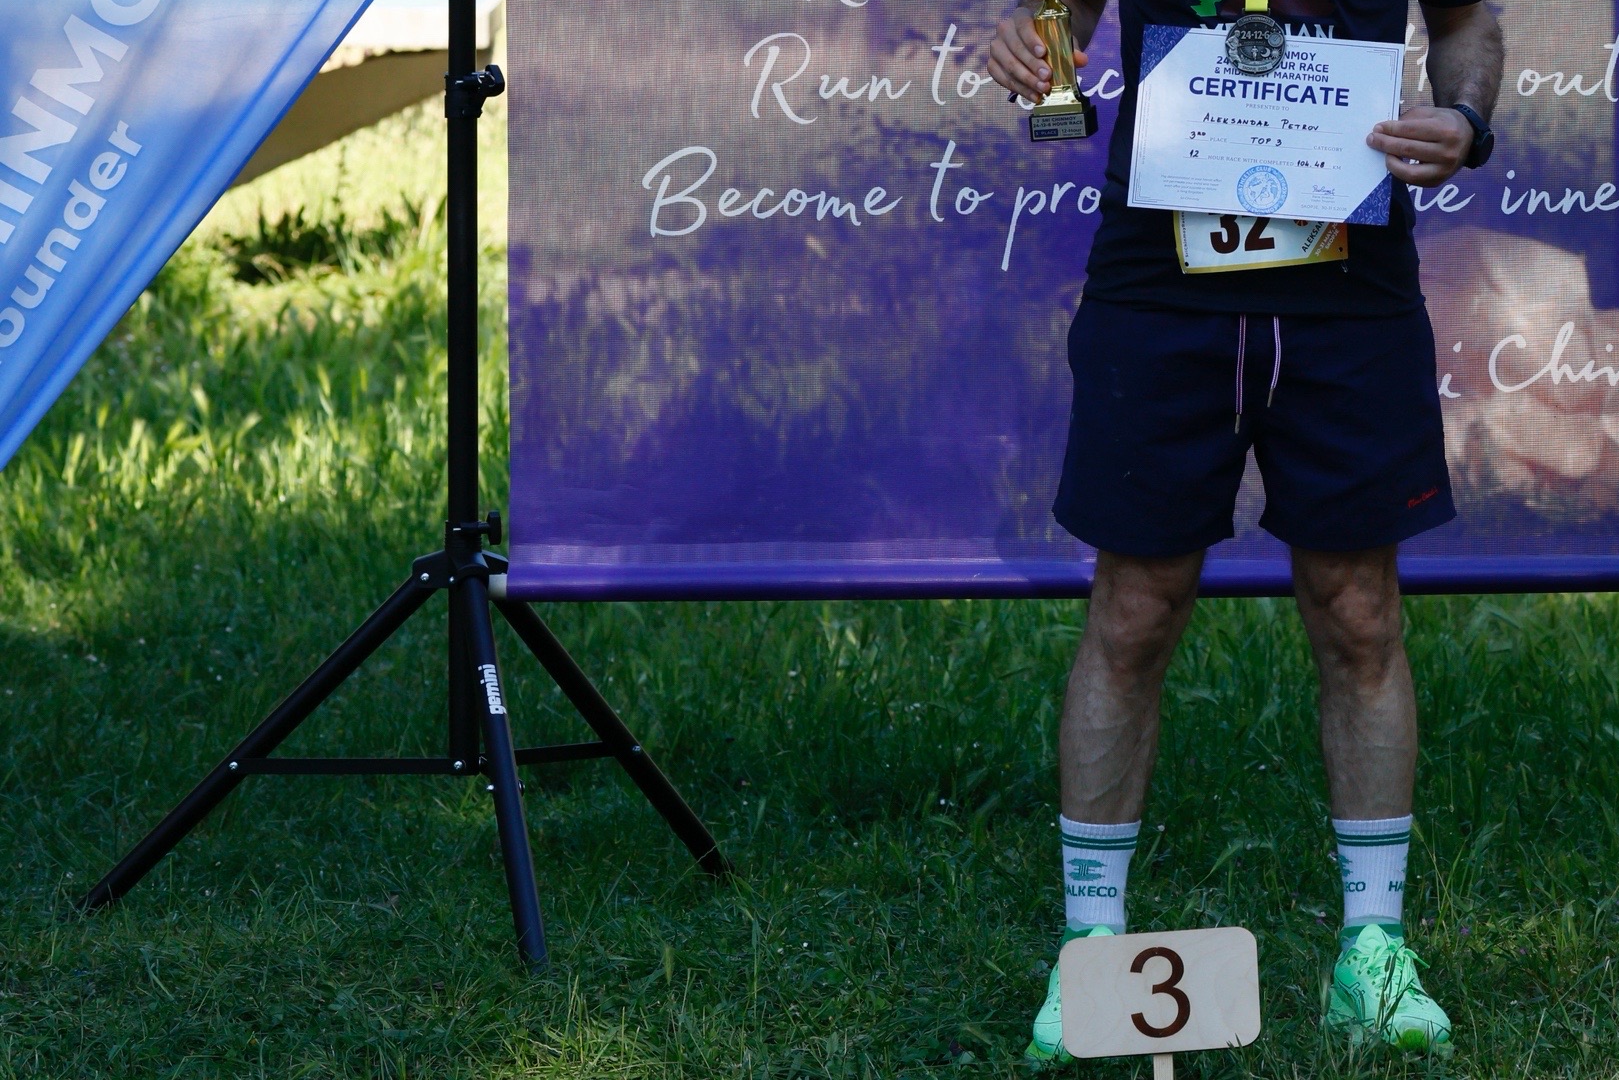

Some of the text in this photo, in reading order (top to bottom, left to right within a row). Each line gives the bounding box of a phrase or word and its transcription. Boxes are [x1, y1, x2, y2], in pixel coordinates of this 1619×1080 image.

[743, 32, 912, 125] Run
[931, 22, 995, 106] to
[1273, 72, 1329, 83] MARATHON
[1300, 62, 1330, 73] RACE
[1188, 76, 1350, 107] CERTIFICATE
[1245, 103, 1278, 111] PRESENTED
[1189, 149, 1199, 159] 12
[1250, 136, 1282, 147] TOP 3
[1259, 159, 1295, 167] COMPLETED
[641, 145, 904, 238] Become
[929, 139, 995, 222] to
[0, 120, 142, 349] ounder
[1209, 212, 1276, 255] 32
[1303, 221, 1325, 253] ALEKSAN
[477, 664, 508, 715] gemini
[1066, 884, 1118, 898] ALKECO
[1129, 946, 1191, 1038] 3
